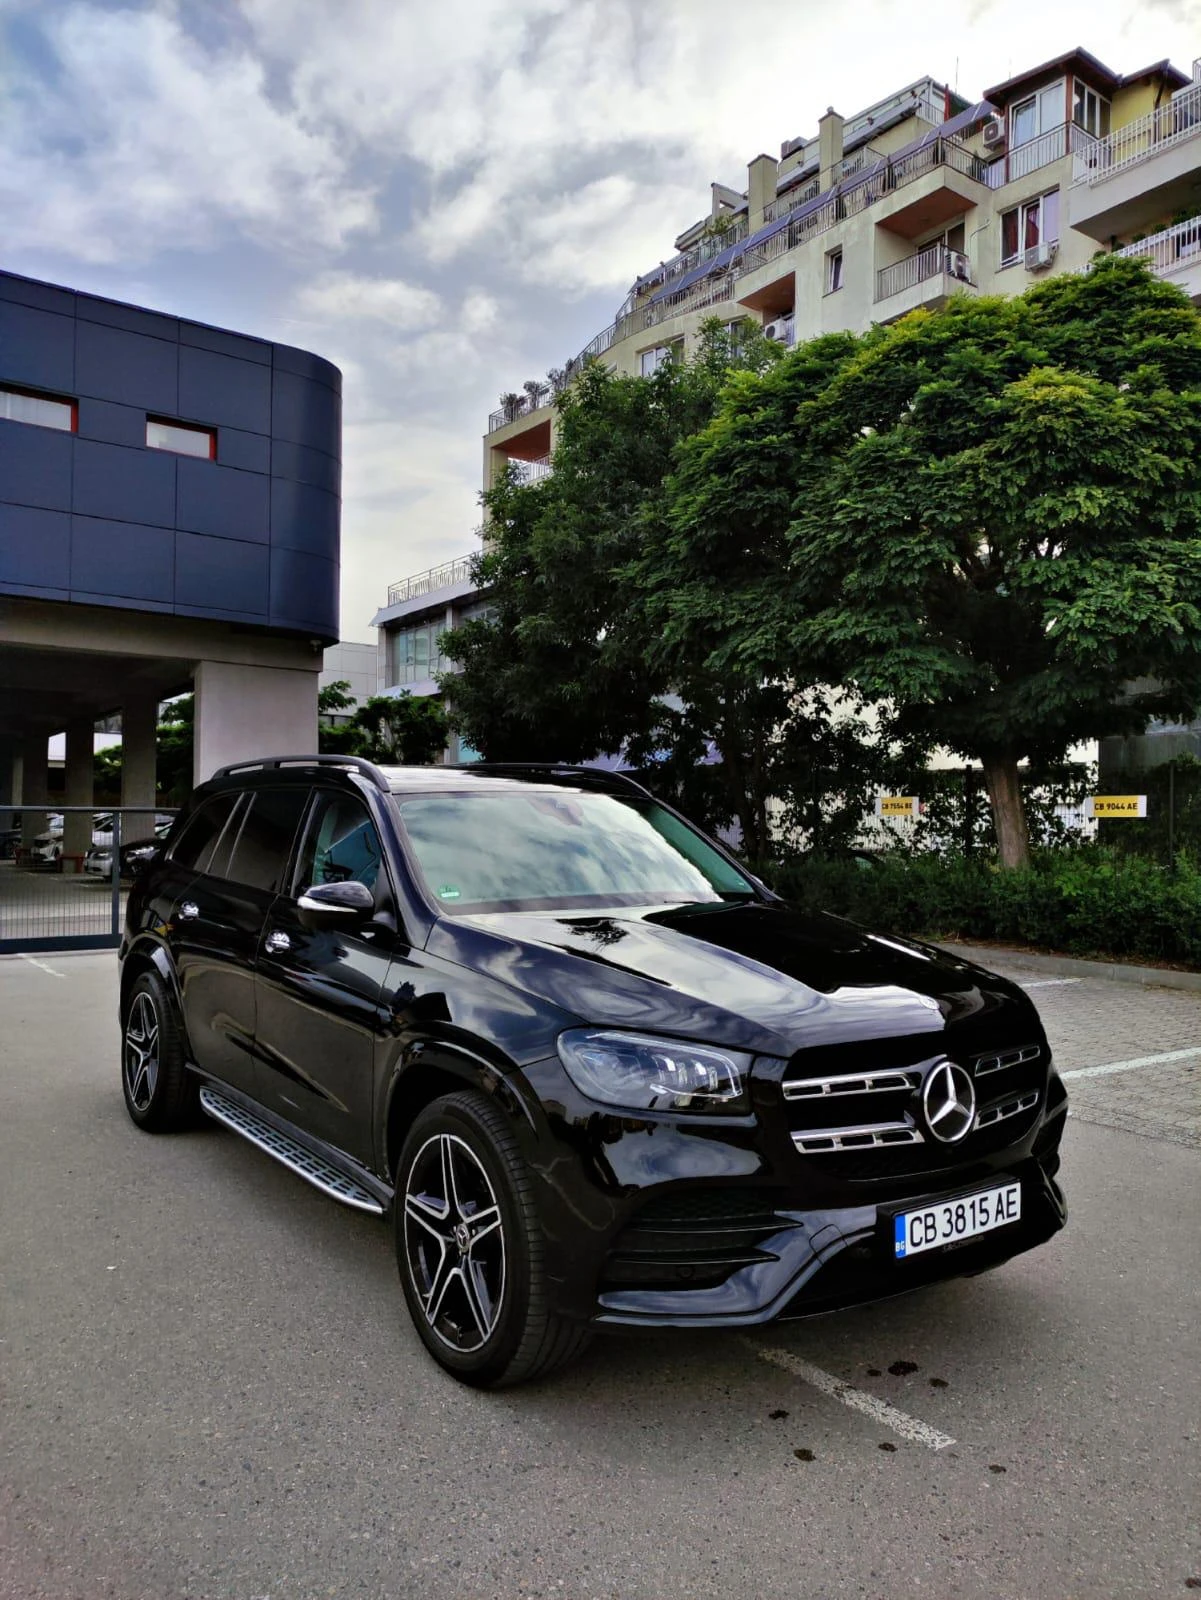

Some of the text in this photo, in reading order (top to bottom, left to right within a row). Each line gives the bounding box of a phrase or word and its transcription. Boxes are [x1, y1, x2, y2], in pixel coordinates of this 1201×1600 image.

[909, 1212, 938, 1248] CB
[941, 1196, 990, 1238] 3815
[994, 1187, 1018, 1223] AE
[895, 1240, 906, 1253] BG
